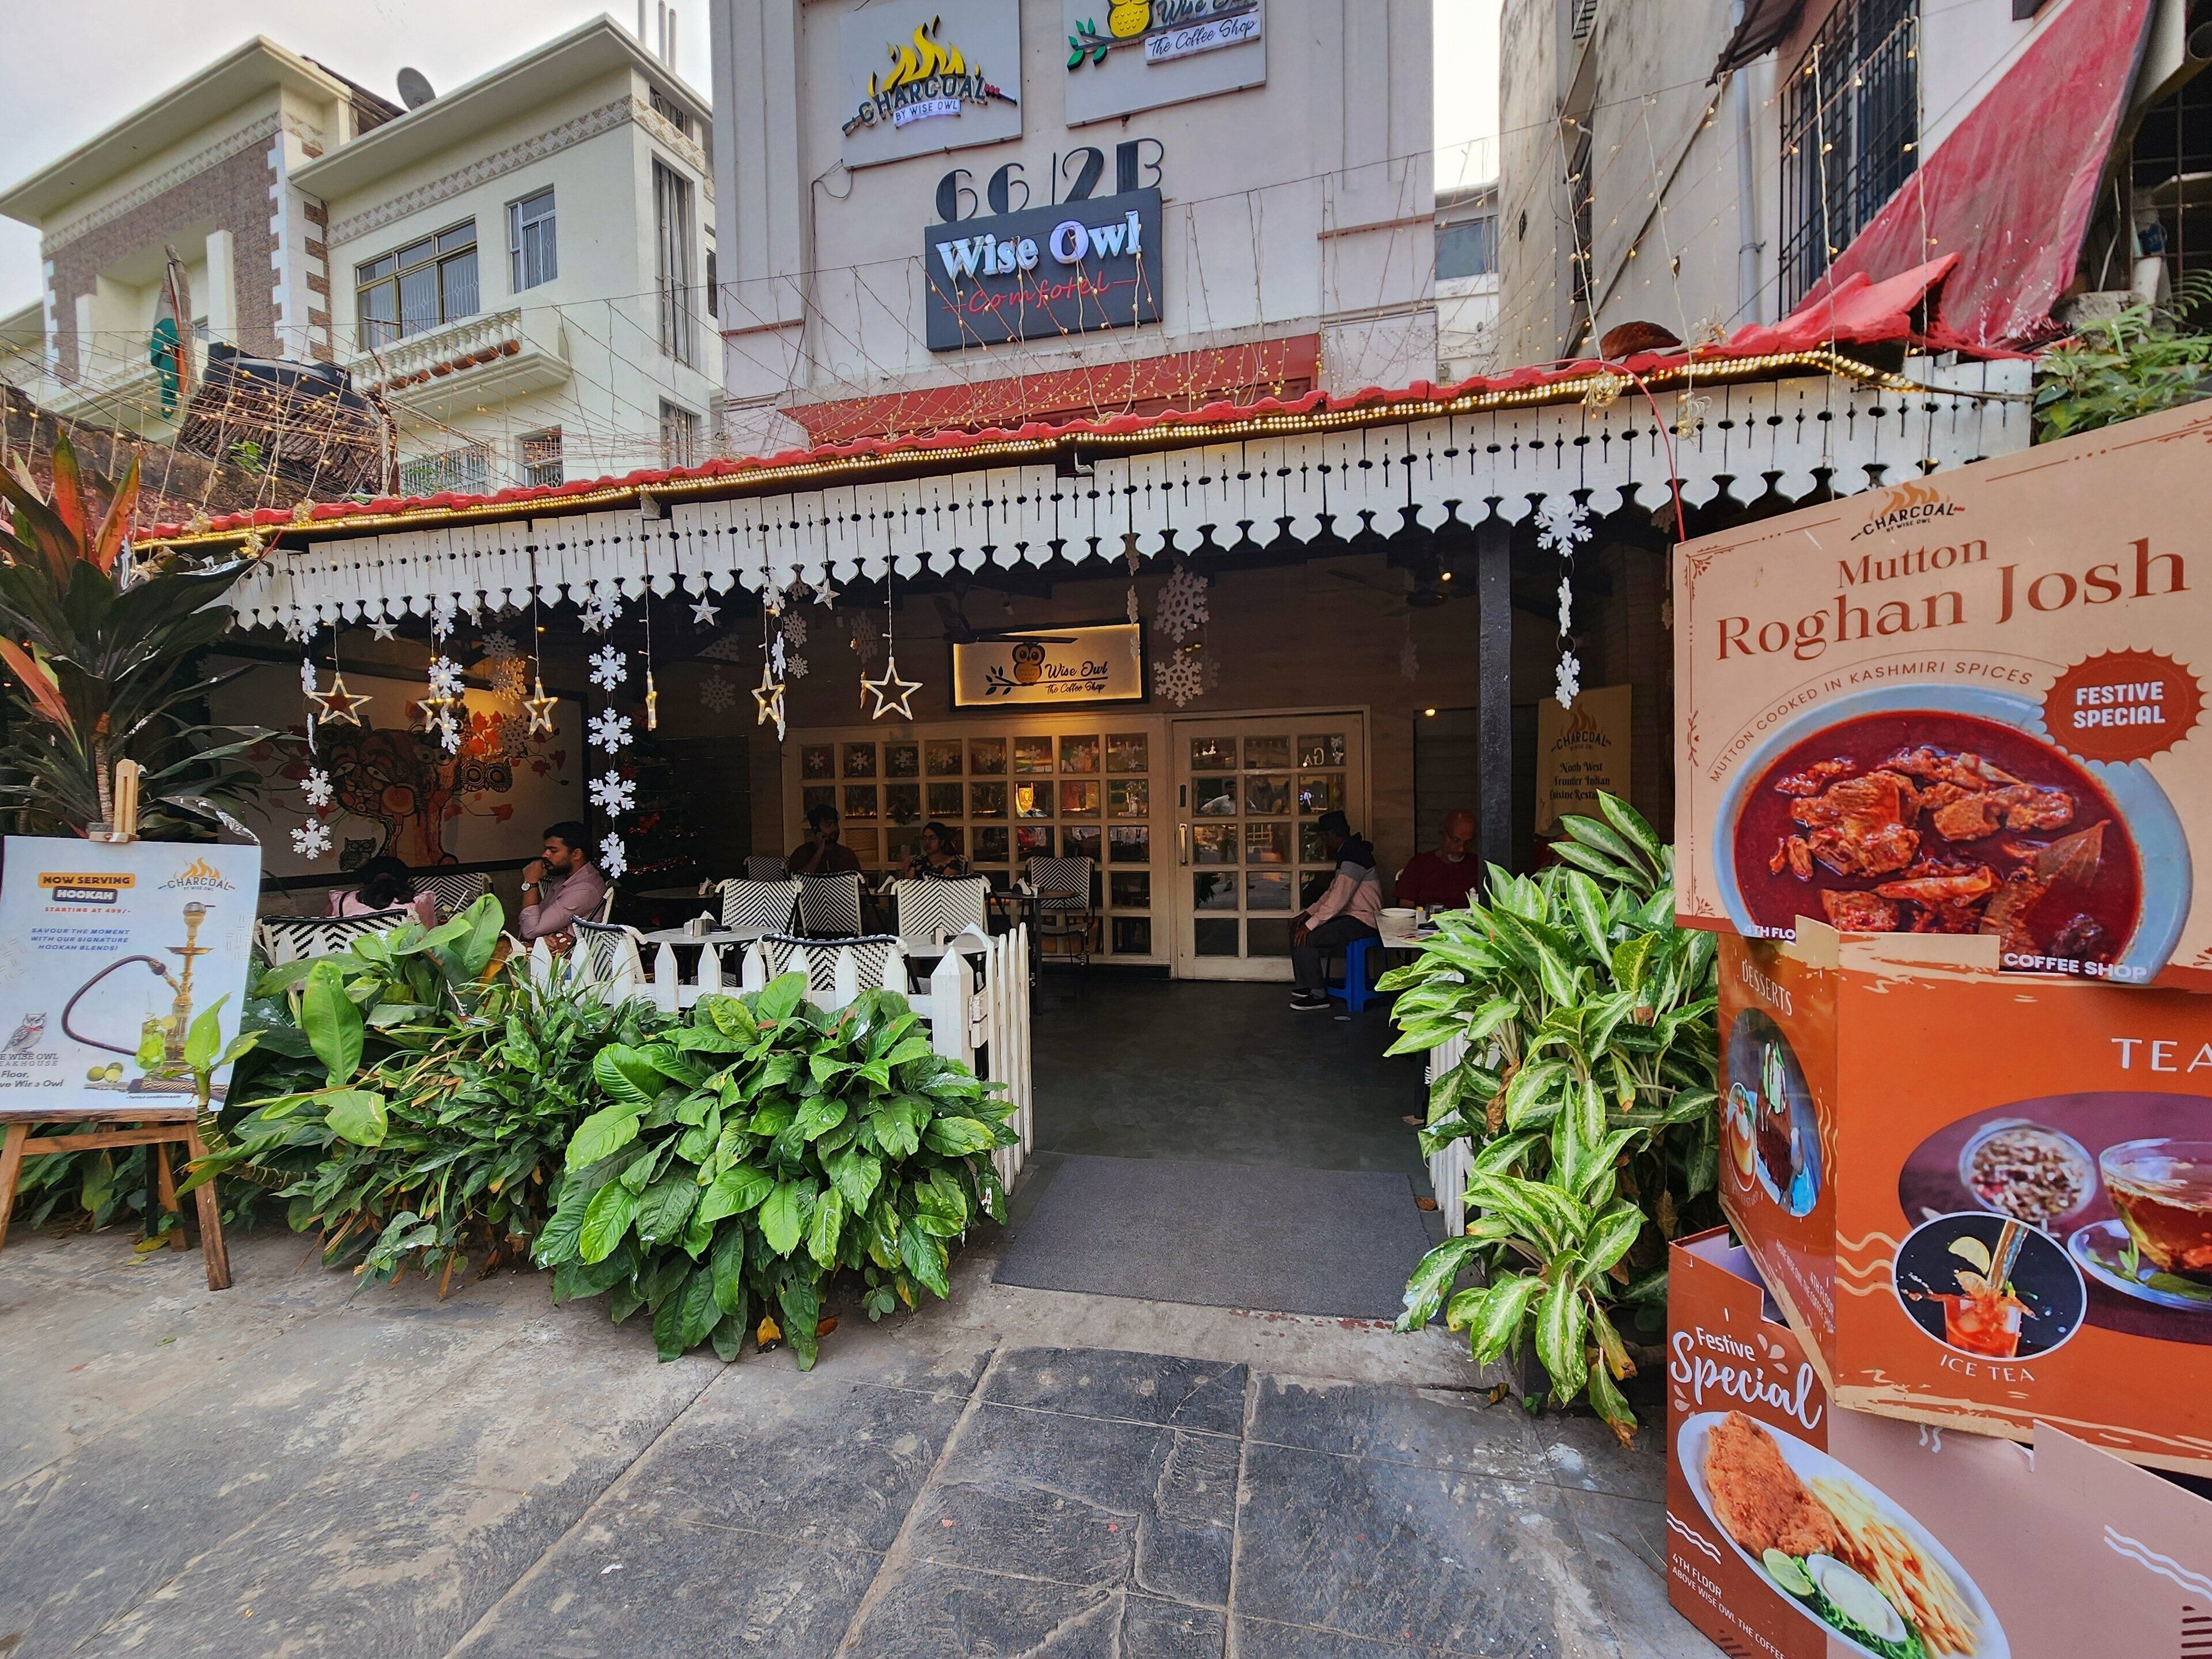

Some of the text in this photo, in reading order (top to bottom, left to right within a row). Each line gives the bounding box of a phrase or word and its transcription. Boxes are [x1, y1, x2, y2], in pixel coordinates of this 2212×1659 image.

[1148, 18, 1257, 56] The Coffee Shop
[858, 75, 987, 124] CHARCOAL
[896, 100, 958, 121] BY WISE OWL
[935, 209, 1142, 281] Wise Owl
[968, 271, 1111, 313] Comfotel
[1863, 503, 1955, 535] CHARCOAL
[1896, 520, 1913, 529] WISE
[1837, 539, 1990, 588] Mutton
[1715, 536, 2192, 661] Roghan Josh
[1044, 661, 1108, 679] Wise Owl
[1060, 683, 1083, 693] Coffee
[1085, 681, 1105, 693] Shop
[2076, 681, 2164, 706] FESTIVE
[1710, 661, 2033, 782] MUTTON COOKED IN KASHMIRI SPICES
[2073, 705, 2166, 729] SPECIAL
[1556, 730, 1606, 749] CHARCOAL
[1560, 761, 1603, 773] North West
[1584, 775, 1610, 786] Indian
[43, 876, 130, 884] NOW SERVING
[168, 877, 229, 891] CHARCOAL
[56, 889, 114, 900] HOOKAH
[1744, 925, 1770, 937] 4TH
[2003, 952, 2147, 980] COFFEE SHOP
[1741, 959, 1793, 1016] DESSERTS
[43, 1079, 64, 1087] Owl
[1696, 1326, 1756, 1362] Festive
[1671, 1331, 1823, 1430] Special
[1940, 1354, 2035, 1382] ICE TEA
[1672, 1553, 1722, 1599] 4TH FLOOR
[1672, 1566, 1696, 1591] ABOVE
[1698, 1586, 1717, 1608] WISE
[1718, 1603, 1737, 1624] OWL
[1738, 1618, 1753, 1638] THE
